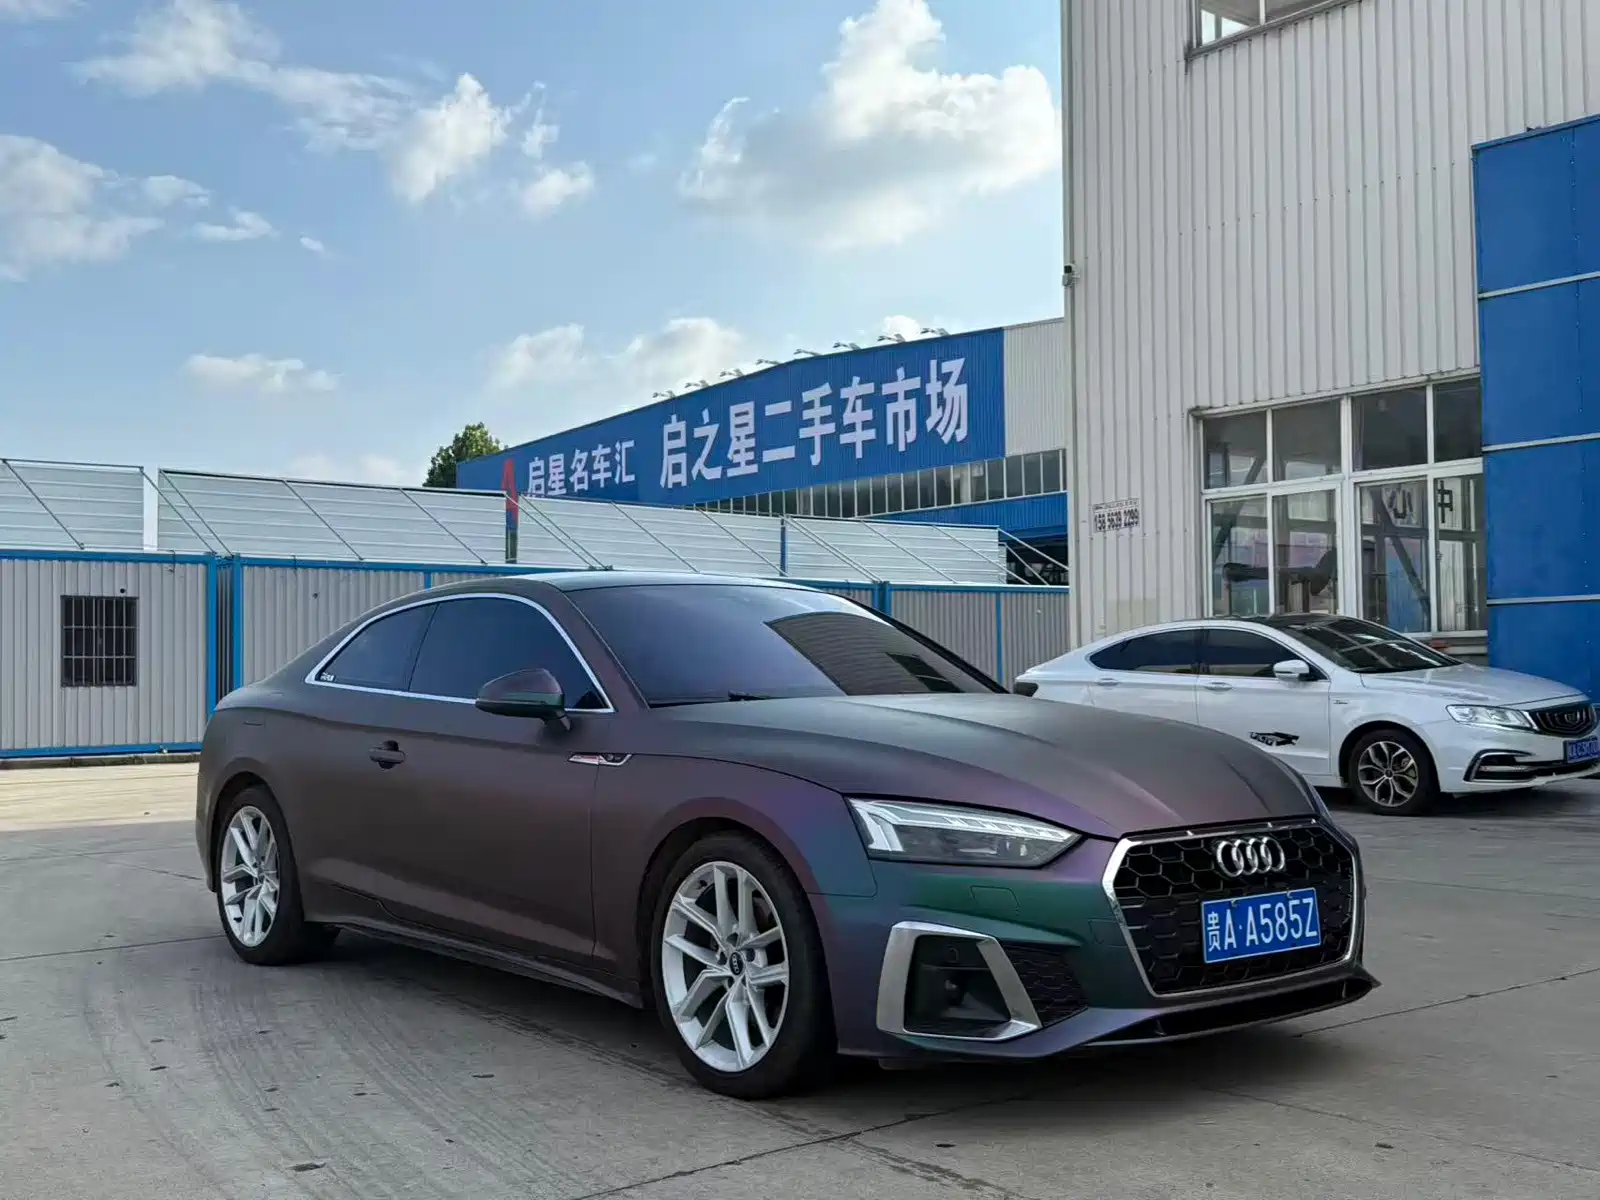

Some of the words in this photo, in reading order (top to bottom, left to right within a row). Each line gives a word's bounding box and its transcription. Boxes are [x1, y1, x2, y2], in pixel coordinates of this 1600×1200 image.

[527, 440, 636, 497] 启星名车汇
[660, 358, 968, 488] 启之星二手车市场
